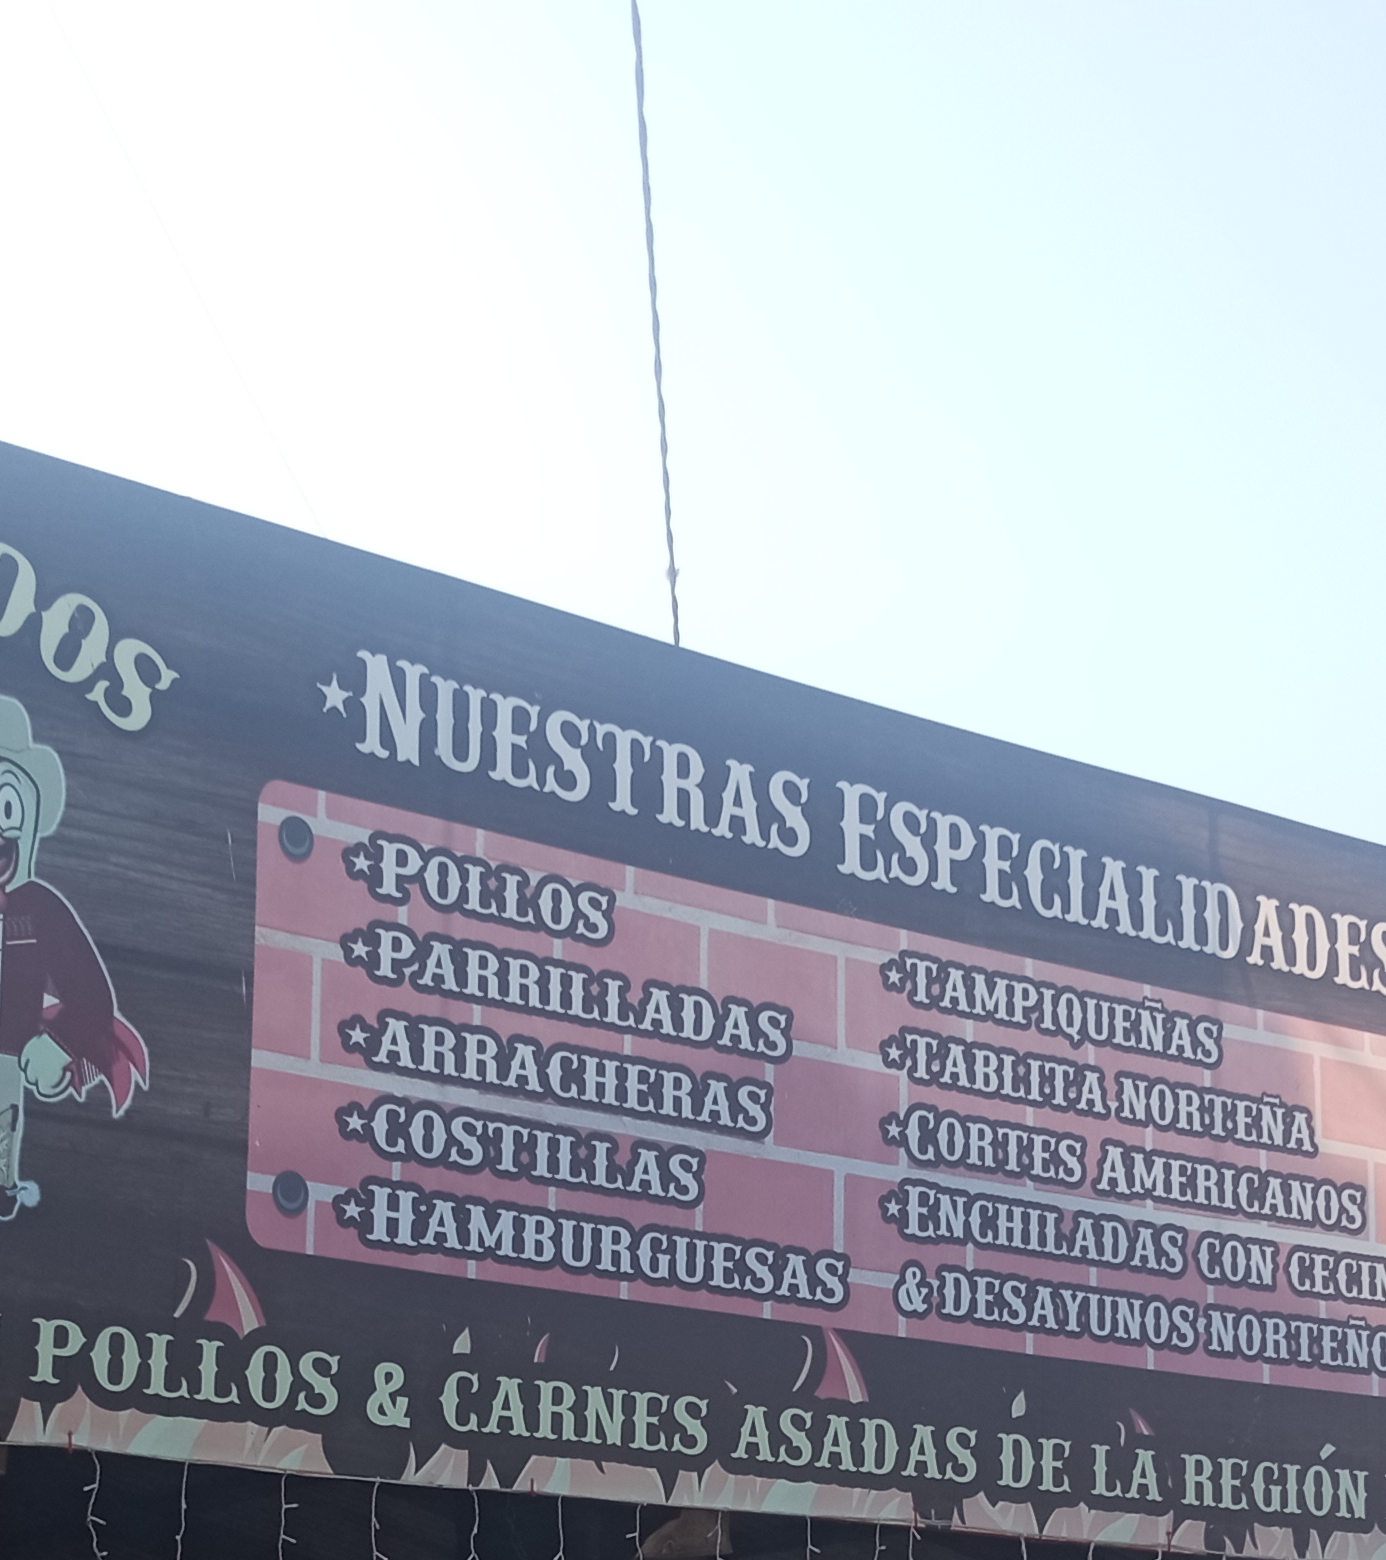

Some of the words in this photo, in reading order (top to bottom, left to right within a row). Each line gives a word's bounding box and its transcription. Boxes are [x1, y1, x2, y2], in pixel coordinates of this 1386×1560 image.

[355, 650, 811, 858] NUESTRAS
[374, 839, 611, 941] POLLOS
[374, 928, 789, 1058] PARRILLADAS
[905, 959, 1222, 1064] TAMPIQUEÑAS
[372, 1018, 769, 1133] ARRACHERAS
[905, 1034, 1107, 1114] TABLITA
[1118, 1075, 1316, 1153] NORTEÑA
[370, 1103, 703, 1202] COSTILLAS
[905, 1111, 1083, 1181] CORTES
[1097, 1147, 1364, 1231] AMERICANOS
[366, 1185, 848, 1305] HAMBURGUESAS
[904, 1186, 1185, 1274] ENCHILADAS
[1197, 1237, 1274, 1284] CON
[896, 1267, 929, 1312] &
[941, 1271, 1196, 1348] DESAYUNOS
[30, 1316, 341, 1416] POLLOS
[366, 1361, 411, 1429] &
[439, 1370, 710, 1457] CARNES
[730, 1405, 978, 1485] ASADAS
[995, 1432, 1073, 1492] DE
[1090, 1443, 1164, 1503] LA
[1182, 1443, 1370, 1521] REGIÓN
